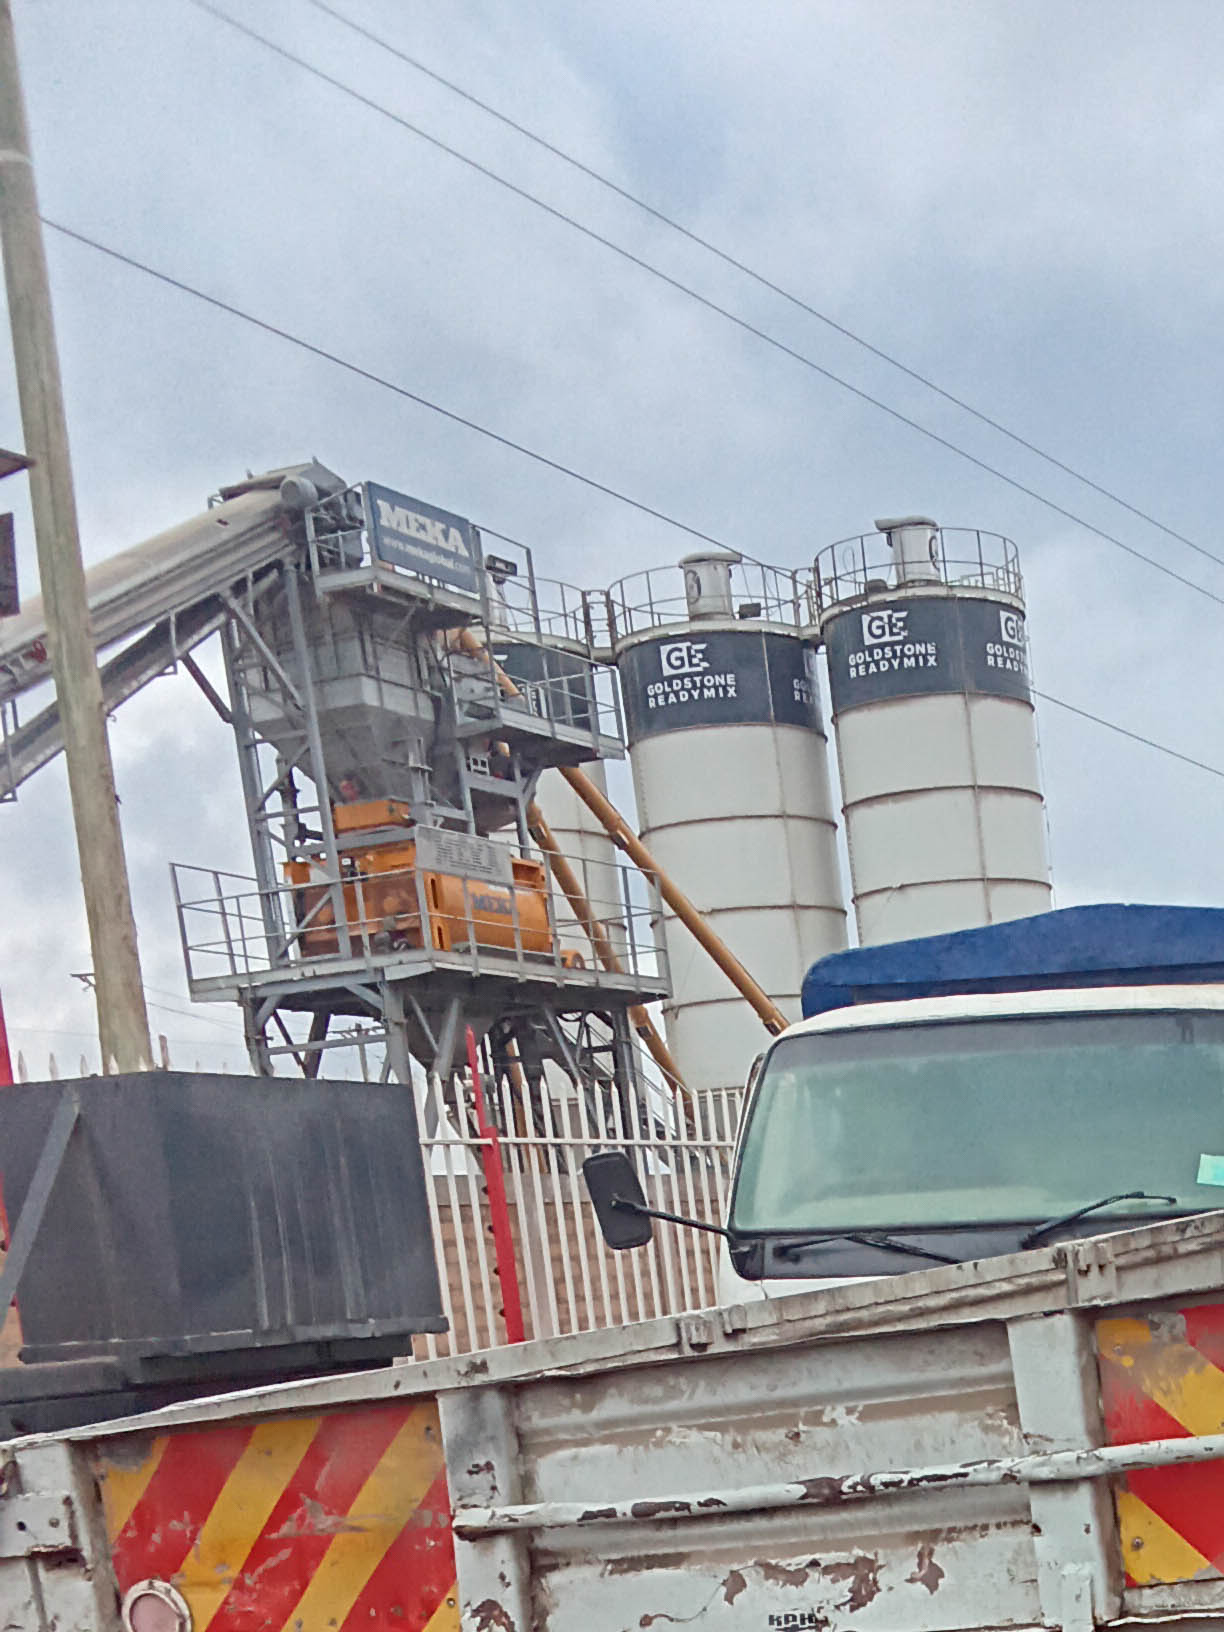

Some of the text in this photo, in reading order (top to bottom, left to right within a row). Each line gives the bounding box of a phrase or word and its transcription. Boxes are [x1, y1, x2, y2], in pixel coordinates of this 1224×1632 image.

[376, 499, 469, 557] MEKA
[848, 642, 936, 666] GOLDSTONE
[849, 655, 937, 679] READYMIX
[647, 673, 736, 696] GOLDSTONE
[648, 686, 737, 709] READYMIX
